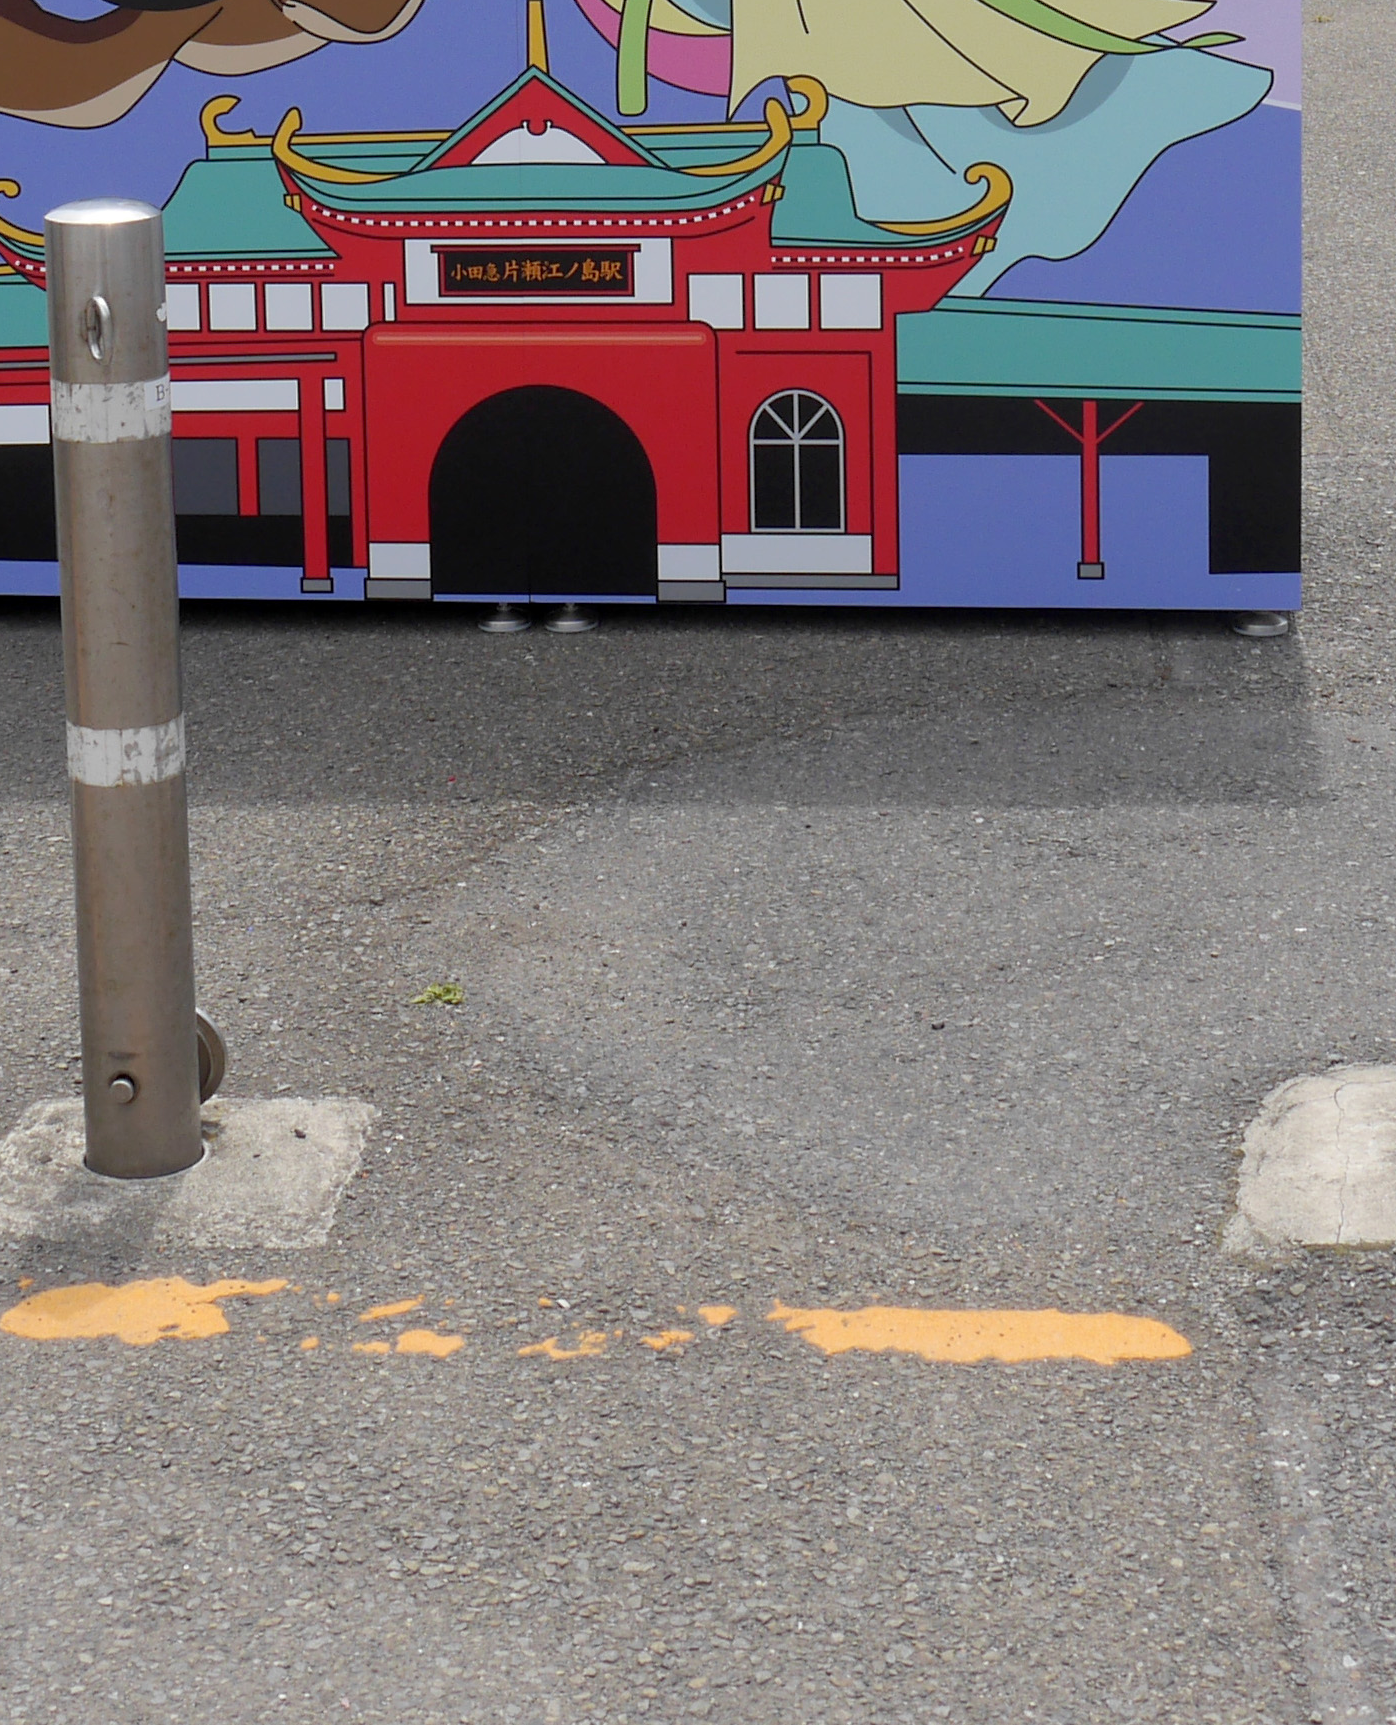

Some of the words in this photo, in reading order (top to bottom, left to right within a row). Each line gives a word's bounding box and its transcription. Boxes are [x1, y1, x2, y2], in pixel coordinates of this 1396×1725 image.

[451, 257, 624, 283] 小田急片瀬江ノ島駅
